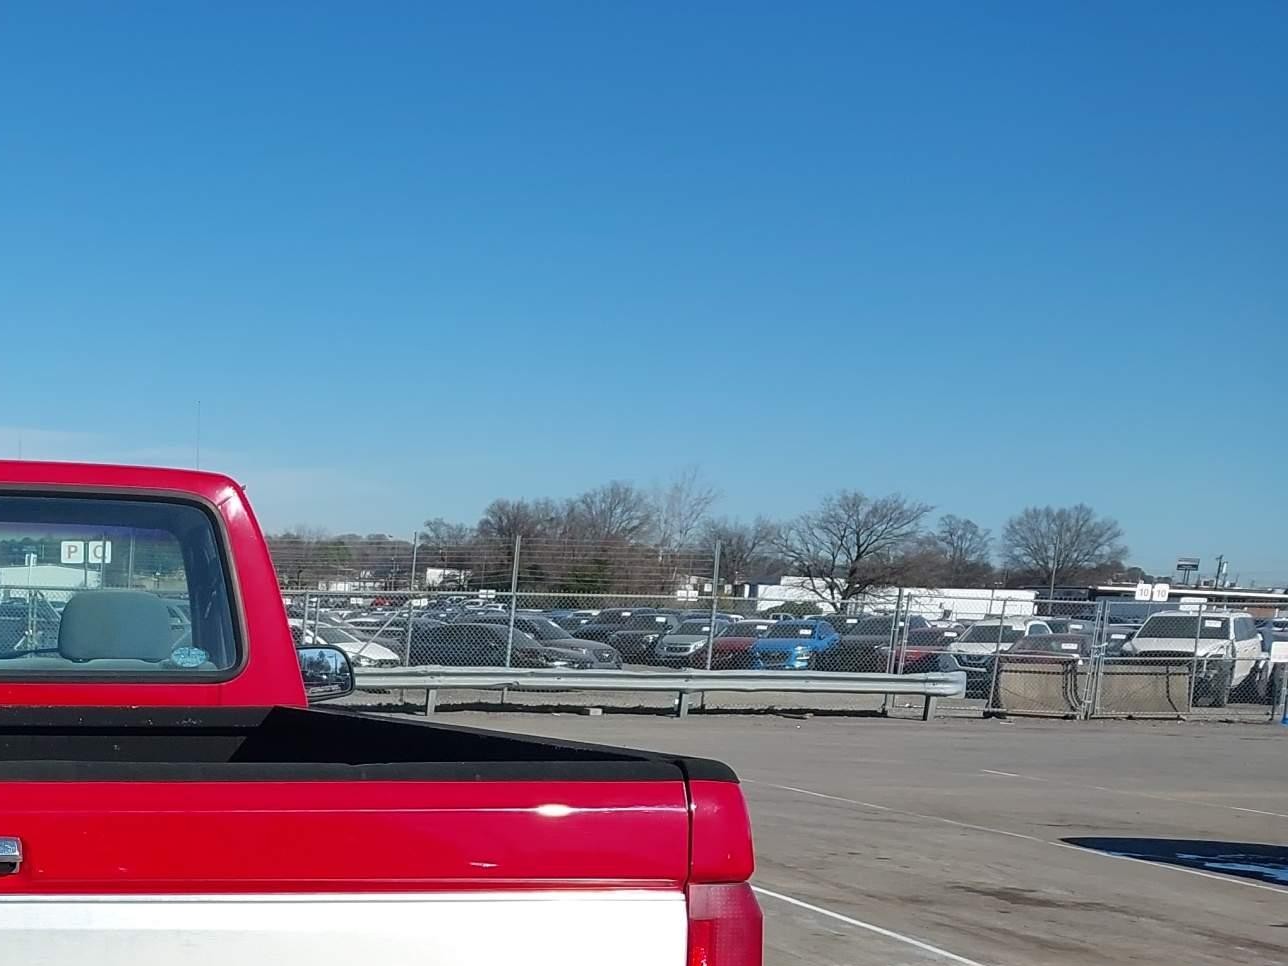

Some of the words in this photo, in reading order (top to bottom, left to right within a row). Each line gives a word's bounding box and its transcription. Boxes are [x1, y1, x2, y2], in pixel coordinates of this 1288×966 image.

[67, 544, 79, 560] P
[1139, 588, 1149, 597] 10
[1157, 589, 1167, 598] 10
